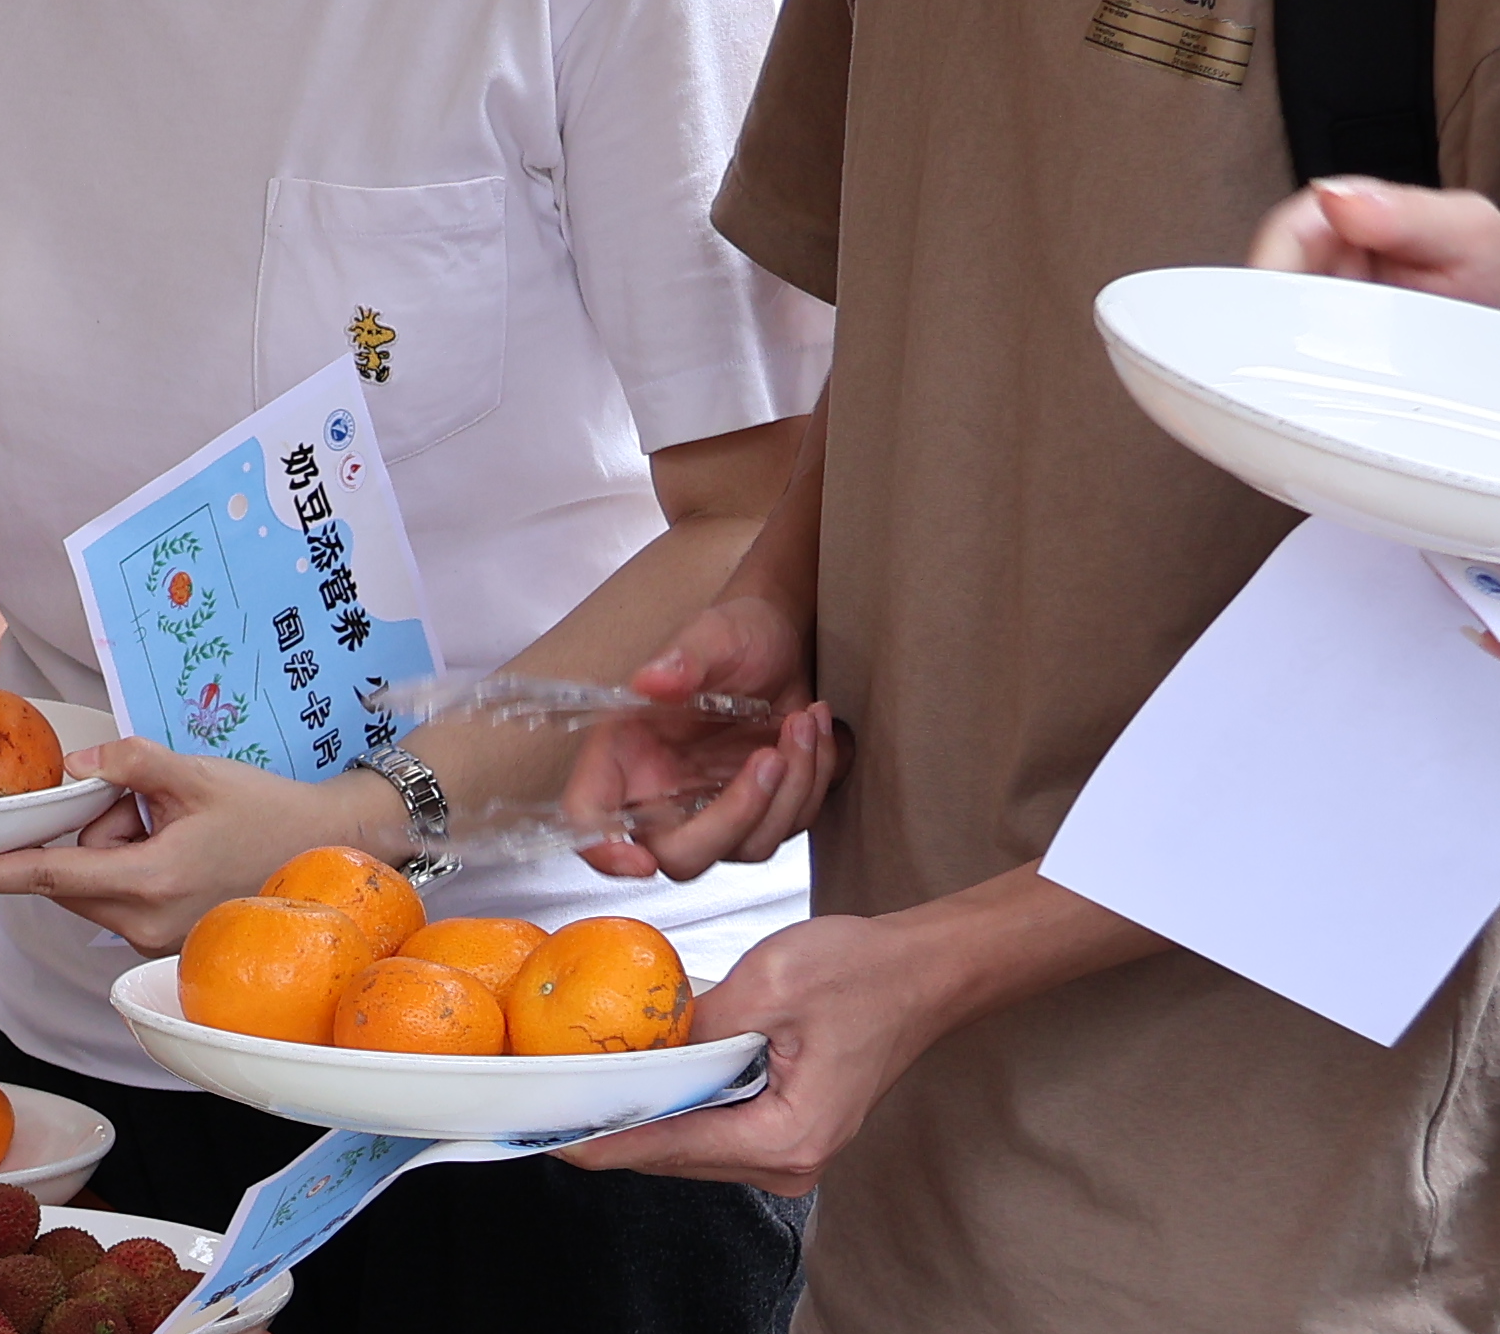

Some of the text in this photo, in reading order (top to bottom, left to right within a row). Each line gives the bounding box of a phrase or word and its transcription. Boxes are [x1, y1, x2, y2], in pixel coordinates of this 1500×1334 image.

[280, 442, 371, 653] 奶豆添营养
[272, 606, 343, 769] 闯关卡片
